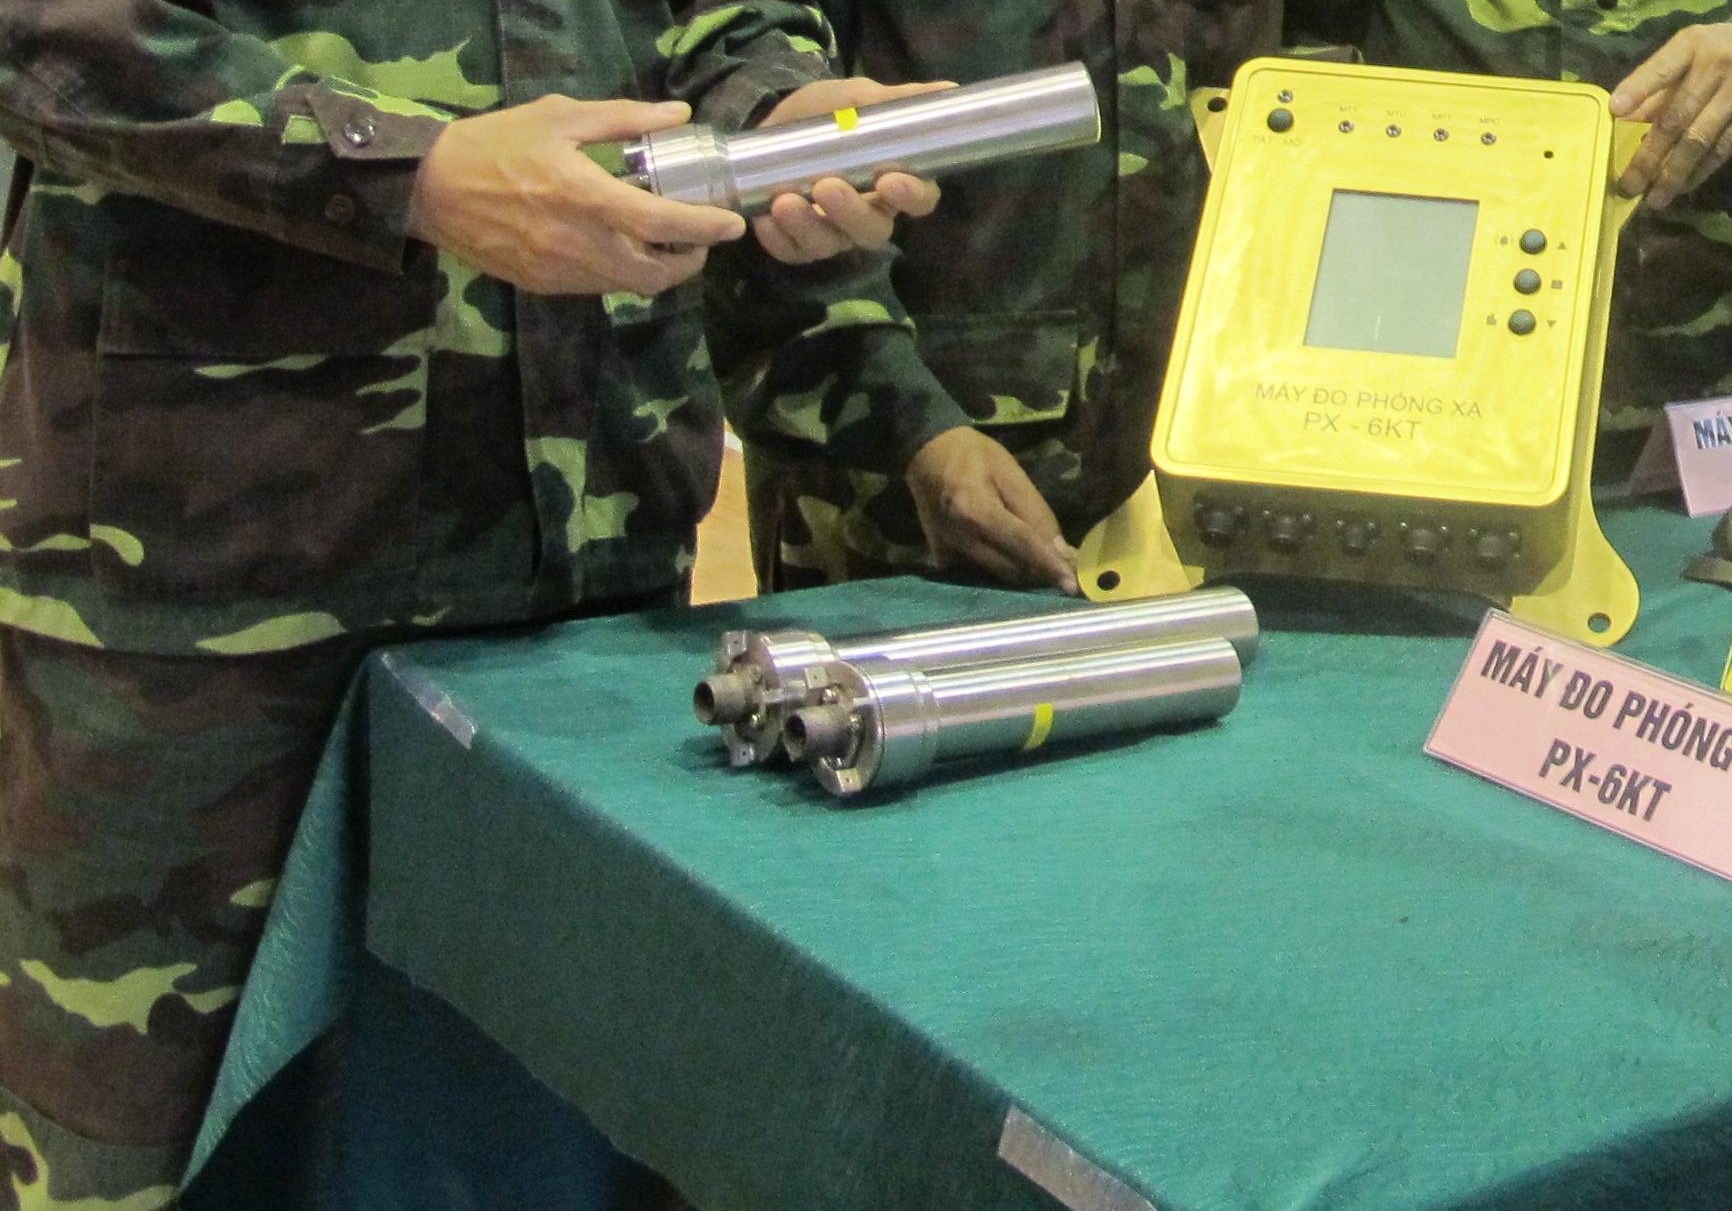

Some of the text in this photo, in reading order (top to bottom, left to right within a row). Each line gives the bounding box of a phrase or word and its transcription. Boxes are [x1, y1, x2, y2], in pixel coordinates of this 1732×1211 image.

[1255, 381, 1308, 402] MÁY
[1312, 388, 1348, 406] ĐO
[1304, 411, 1341, 433] PX
[1367, 417, 1422, 440] 6KT
[1480, 639, 1564, 700] MÁY
[1559, 670, 1614, 720] ĐO
[1538, 738, 1673, 823] PX-6KT
